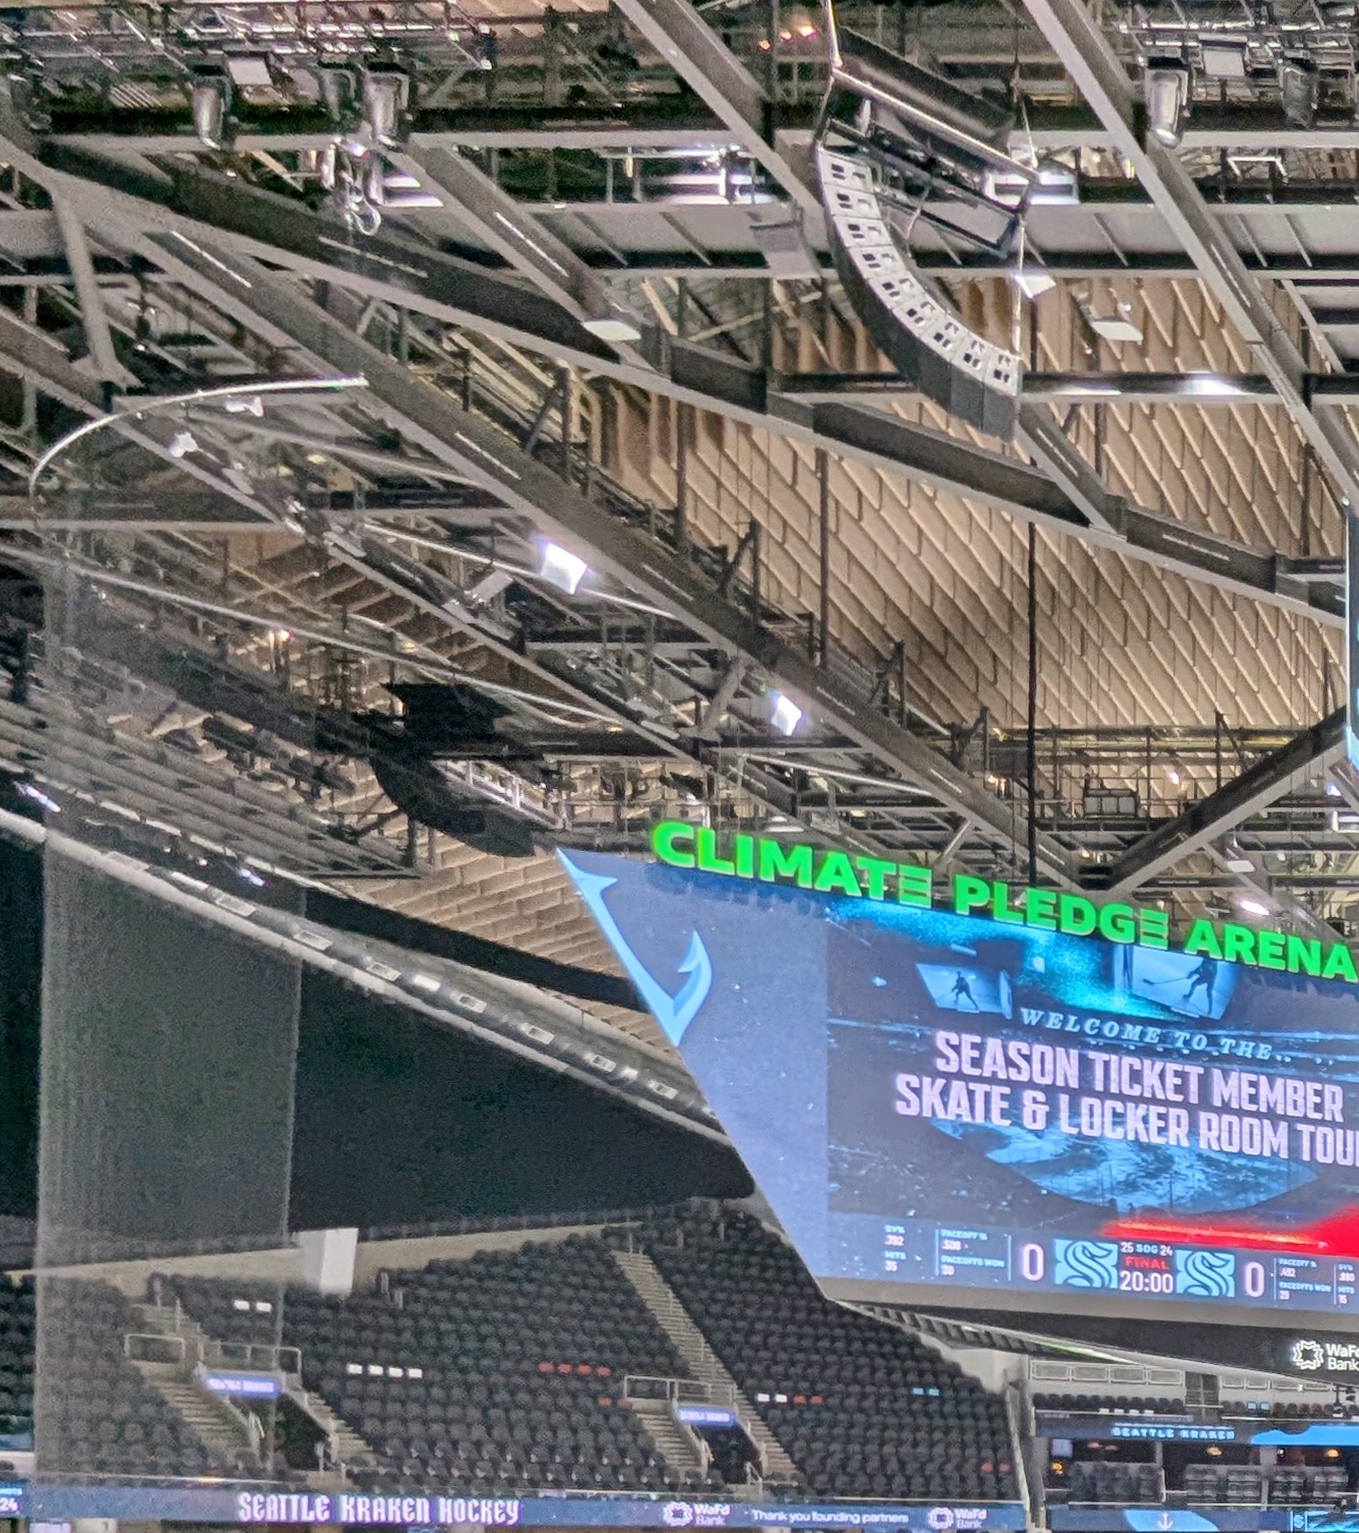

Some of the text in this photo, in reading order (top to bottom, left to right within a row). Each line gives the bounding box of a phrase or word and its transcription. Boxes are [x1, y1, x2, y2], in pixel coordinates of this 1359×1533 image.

[651, 820, 1359, 982] CLIMATE PLEDGE ARENA
[1020, 1008, 1210, 1051] WELCOME TO
[935, 1031, 1344, 1123] SEASON TICKET MEMBER
[896, 1073, 1012, 1128] SKATE
[1022, 1093, 1050, 1131] &
[1060, 1097, 1189, 1149] LOCKER
[1199, 1111, 1289, 1160] ROOM
[941, 1228, 977, 1241] FACEOFF
[1120, 1241, 1135, 1254] 25
[1160, 1244, 1174, 1257] 24
[1021, 1242, 1045, 1282] 0
[1124, 1256, 1170, 1271] FINAL
[1120, 1270, 1174, 1294] 20:00
[1244, 1261, 1266, 1297] 0
[1328, 1355, 1359, 1372] Bank
[1112, 1426, 1236, 1441] SEATTLE KRAKEN
[238, 1492, 522, 1526] SEATTLE KRAKEN HOCKEY
[694, 1504, 731, 1517] WaFd
[954, 1508, 987, 1519] WaFd
[696, 1515, 726, 1527] Bank
[751, 1510, 909, 1526] Thank you founding partners
